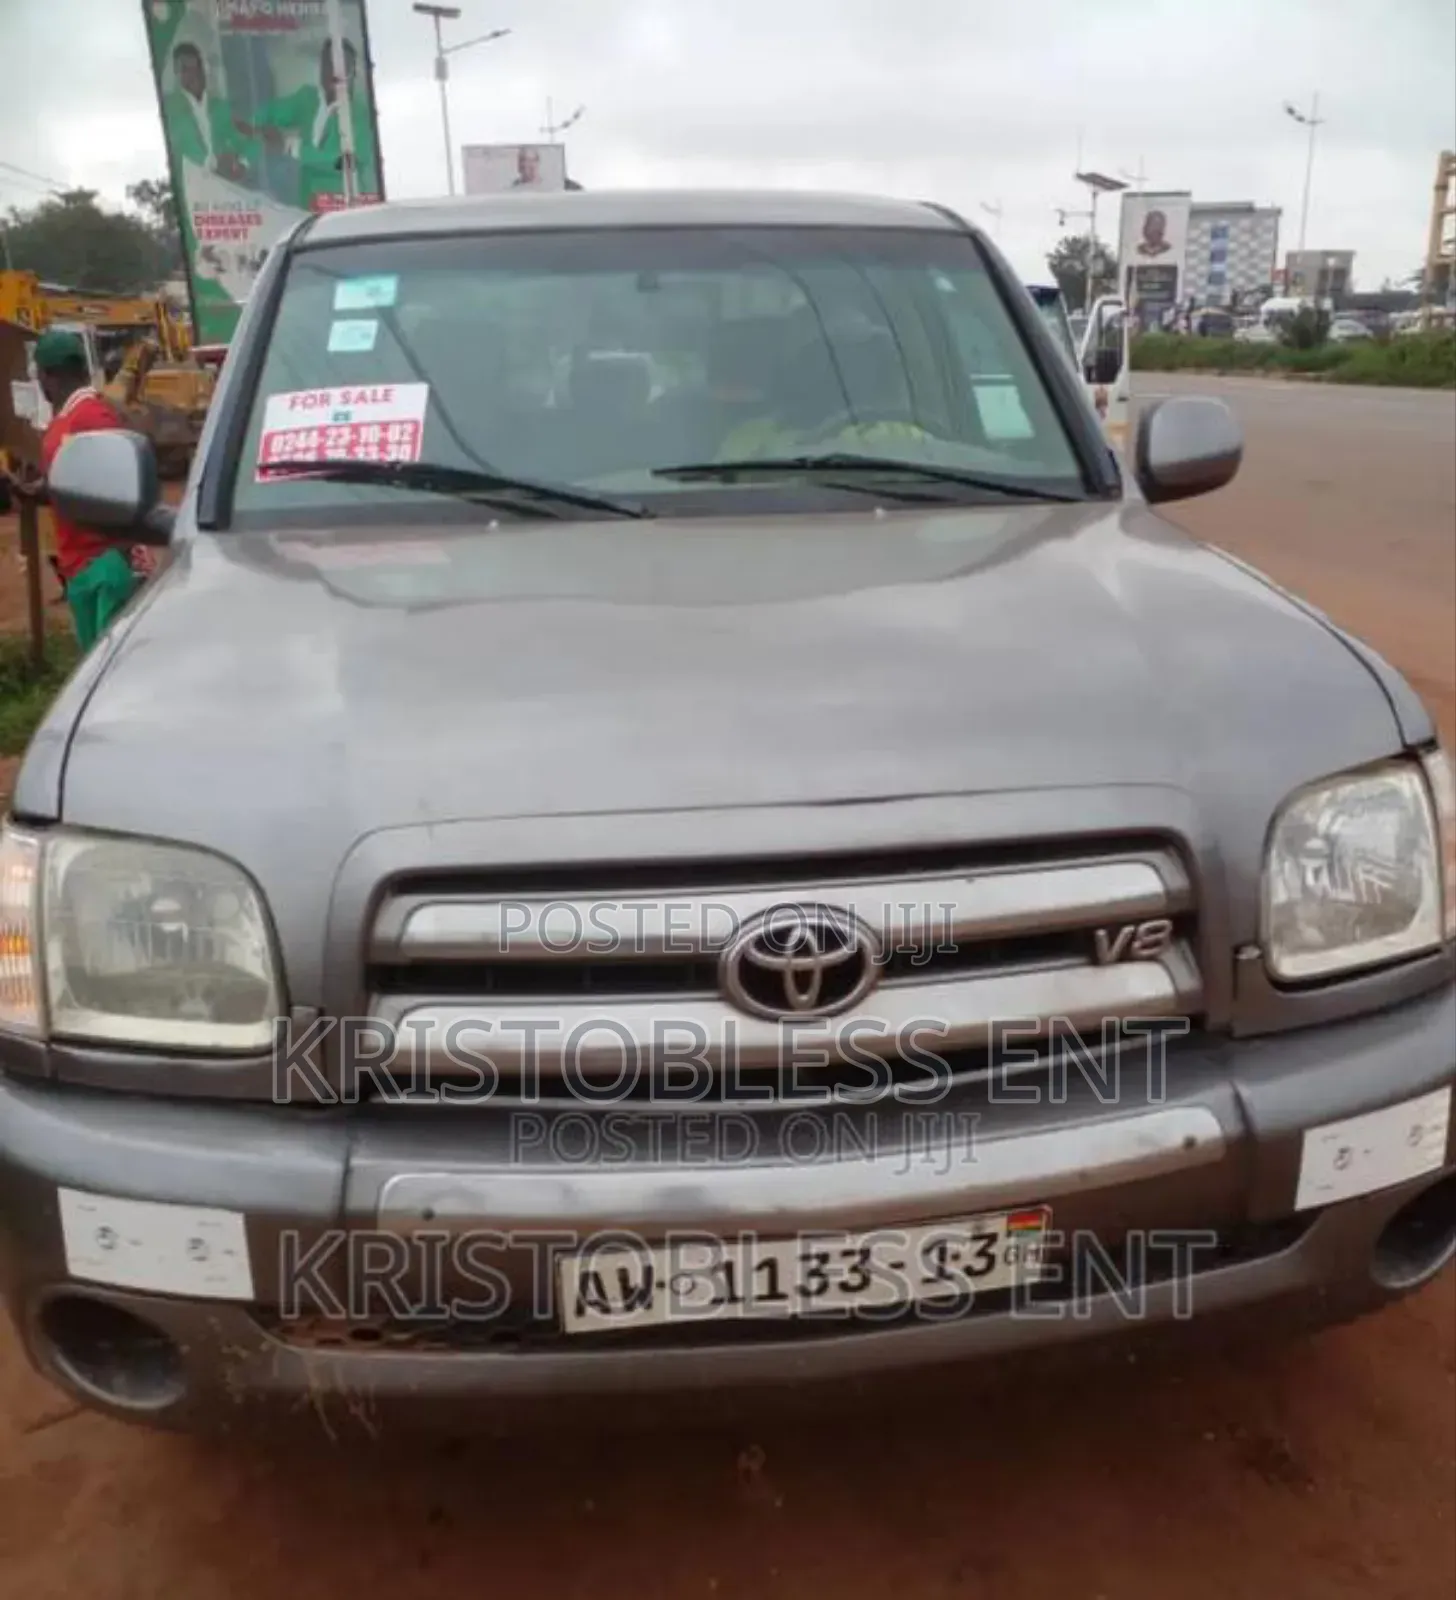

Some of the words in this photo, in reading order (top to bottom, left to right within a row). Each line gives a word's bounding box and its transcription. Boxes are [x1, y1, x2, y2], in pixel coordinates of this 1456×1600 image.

[288, 393, 332, 411] FOR
[340, 387, 396, 406] SALE
[1093, 919, 1173, 963] V8
